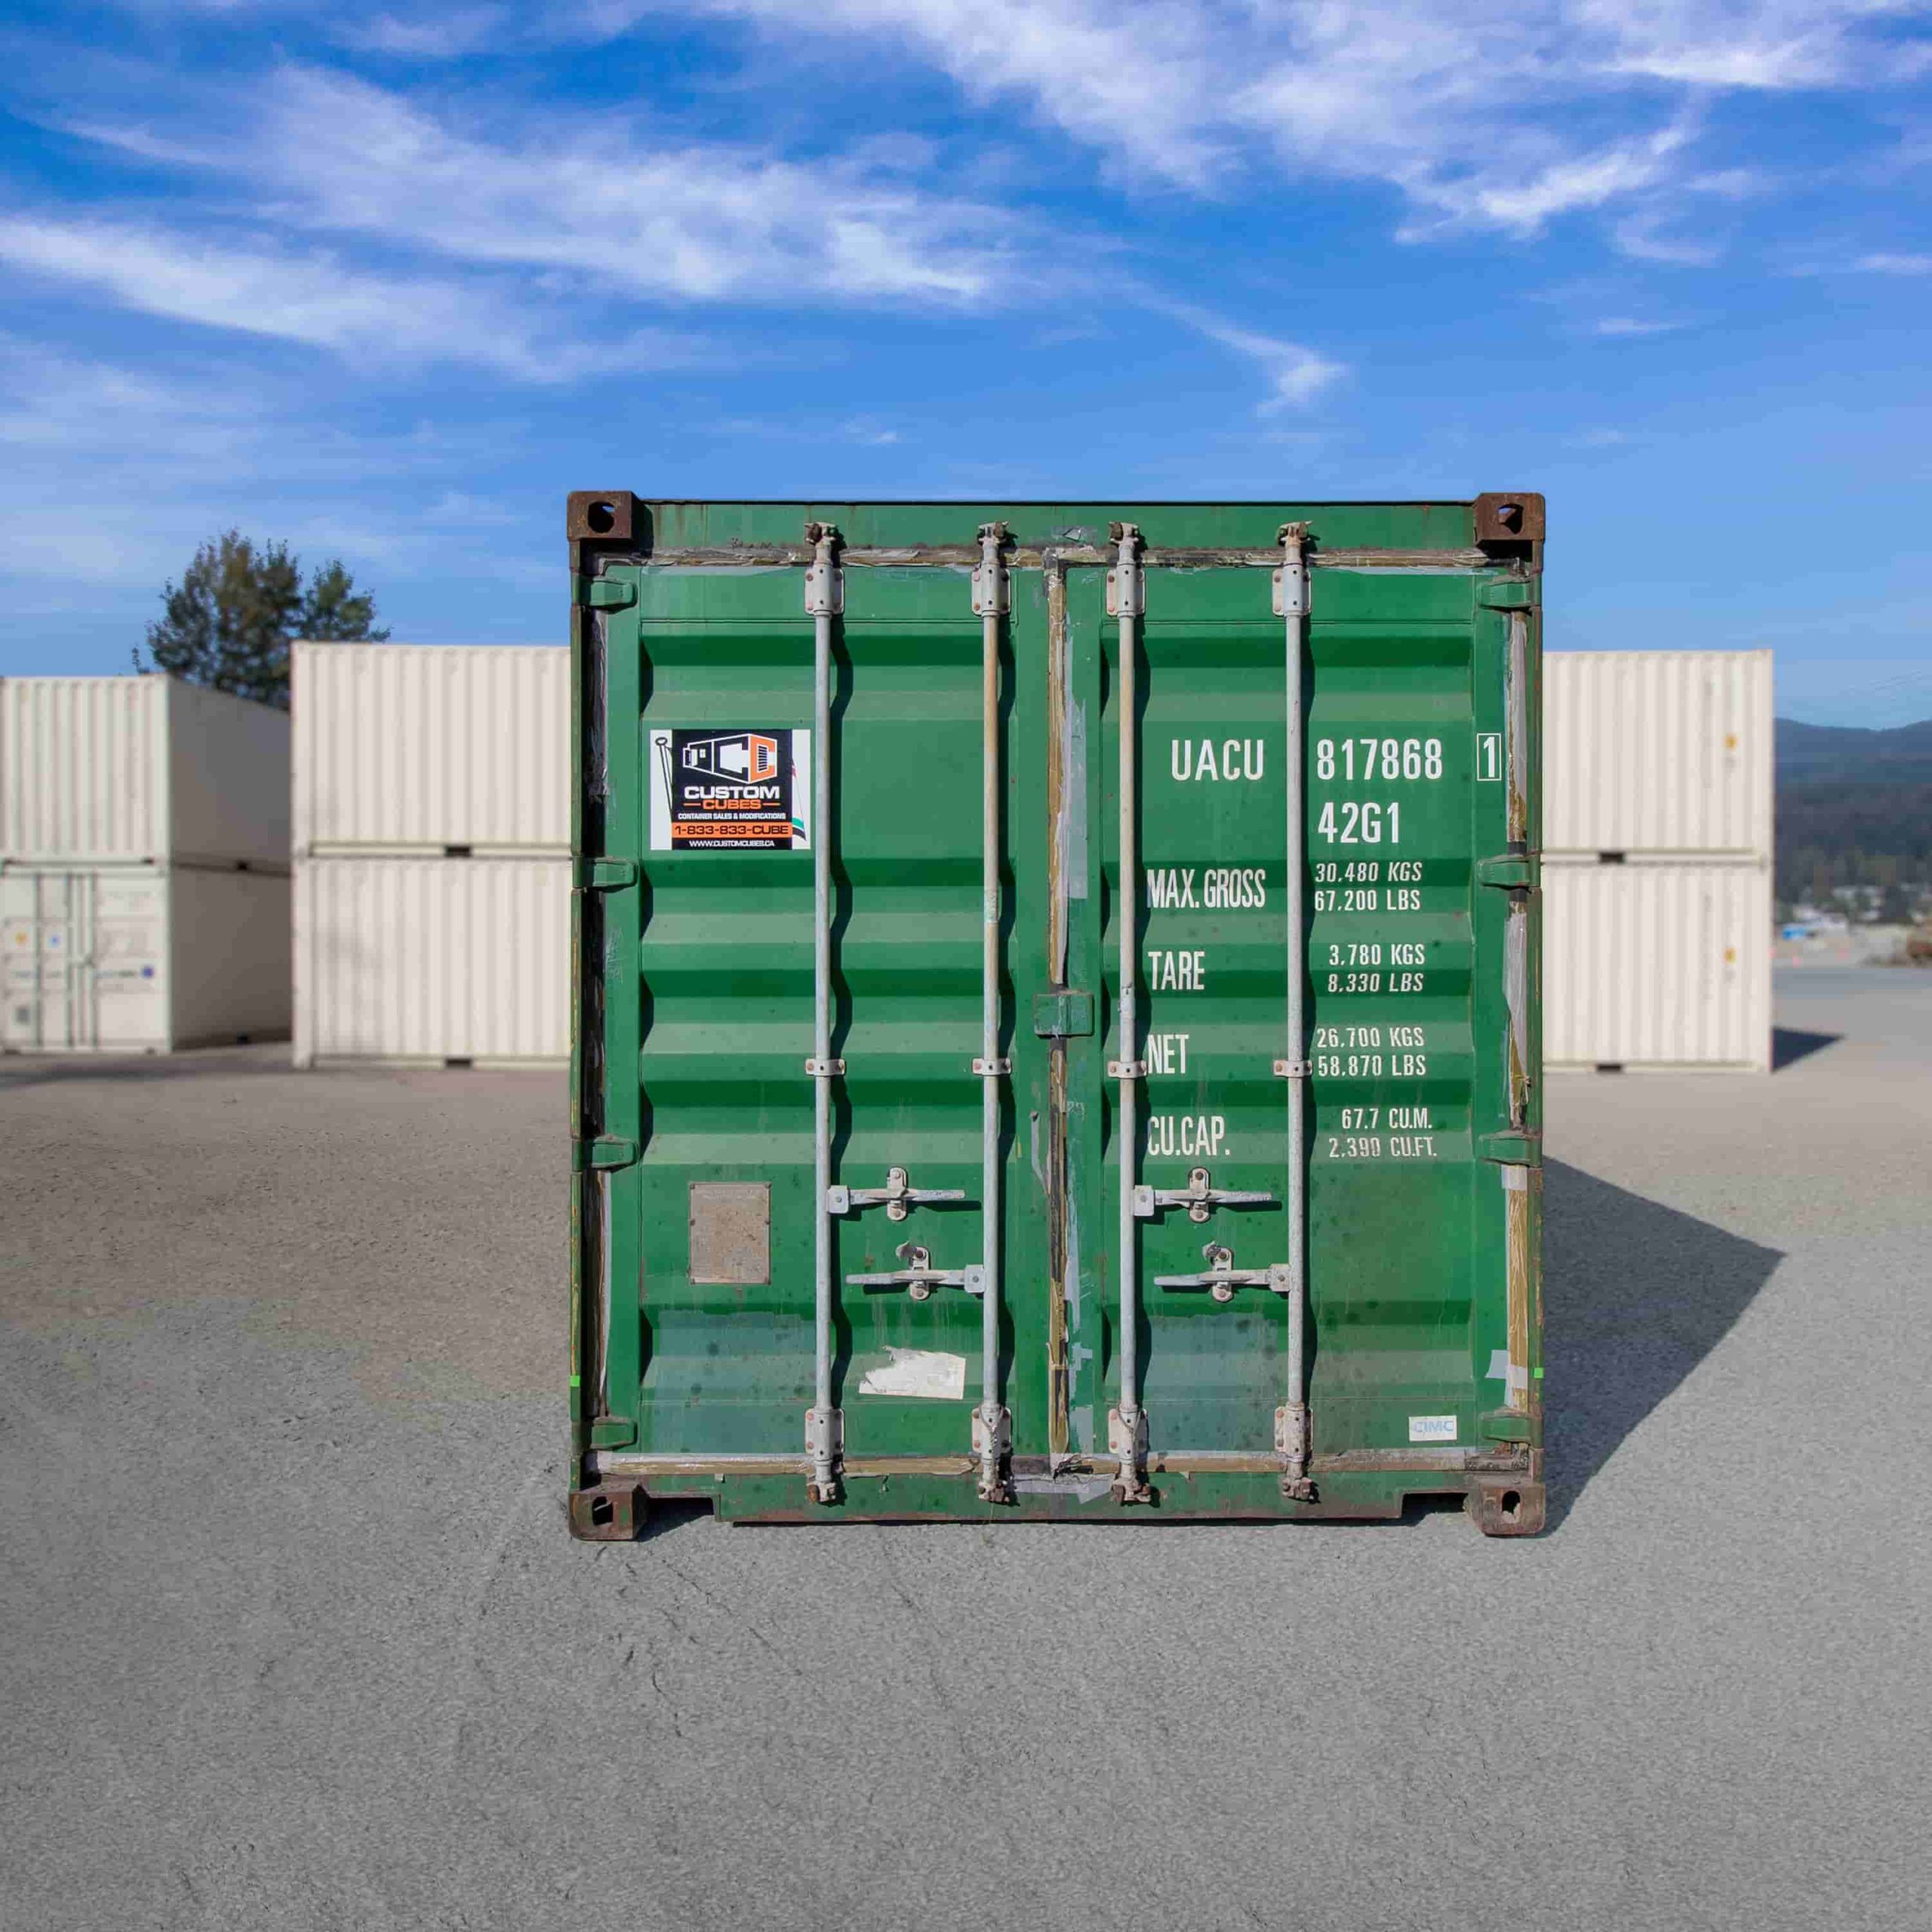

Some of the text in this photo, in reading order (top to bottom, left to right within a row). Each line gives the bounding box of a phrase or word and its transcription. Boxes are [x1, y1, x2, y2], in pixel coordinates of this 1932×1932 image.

[1171, 736, 1495, 781] UACU 817868 1
[684, 786, 780, 799] CUSTOM
[702, 799, 761, 810] CUBES
[675, 825, 789, 835] 1-833-833-CUBE
[1317, 802, 1400, 844] 42G1
[1388, 862, 1423, 881] KGS
[1204, 869, 1266, 909] GROSS
[1386, 889, 1420, 910] LBS
[1390, 943, 1425, 965] KGS
[1147, 951, 1205, 990] TARE
[1389, 973, 1423, 992] LBS
[1389, 1027, 1425, 1047] KGS
[1147, 1034, 1189, 1074] NET
[1392, 1054, 1426, 1076] LBS
[1341, 1107, 1432, 1129] 67.7 CU.M.
[1414, 1420, 1454, 1433] CIMC
